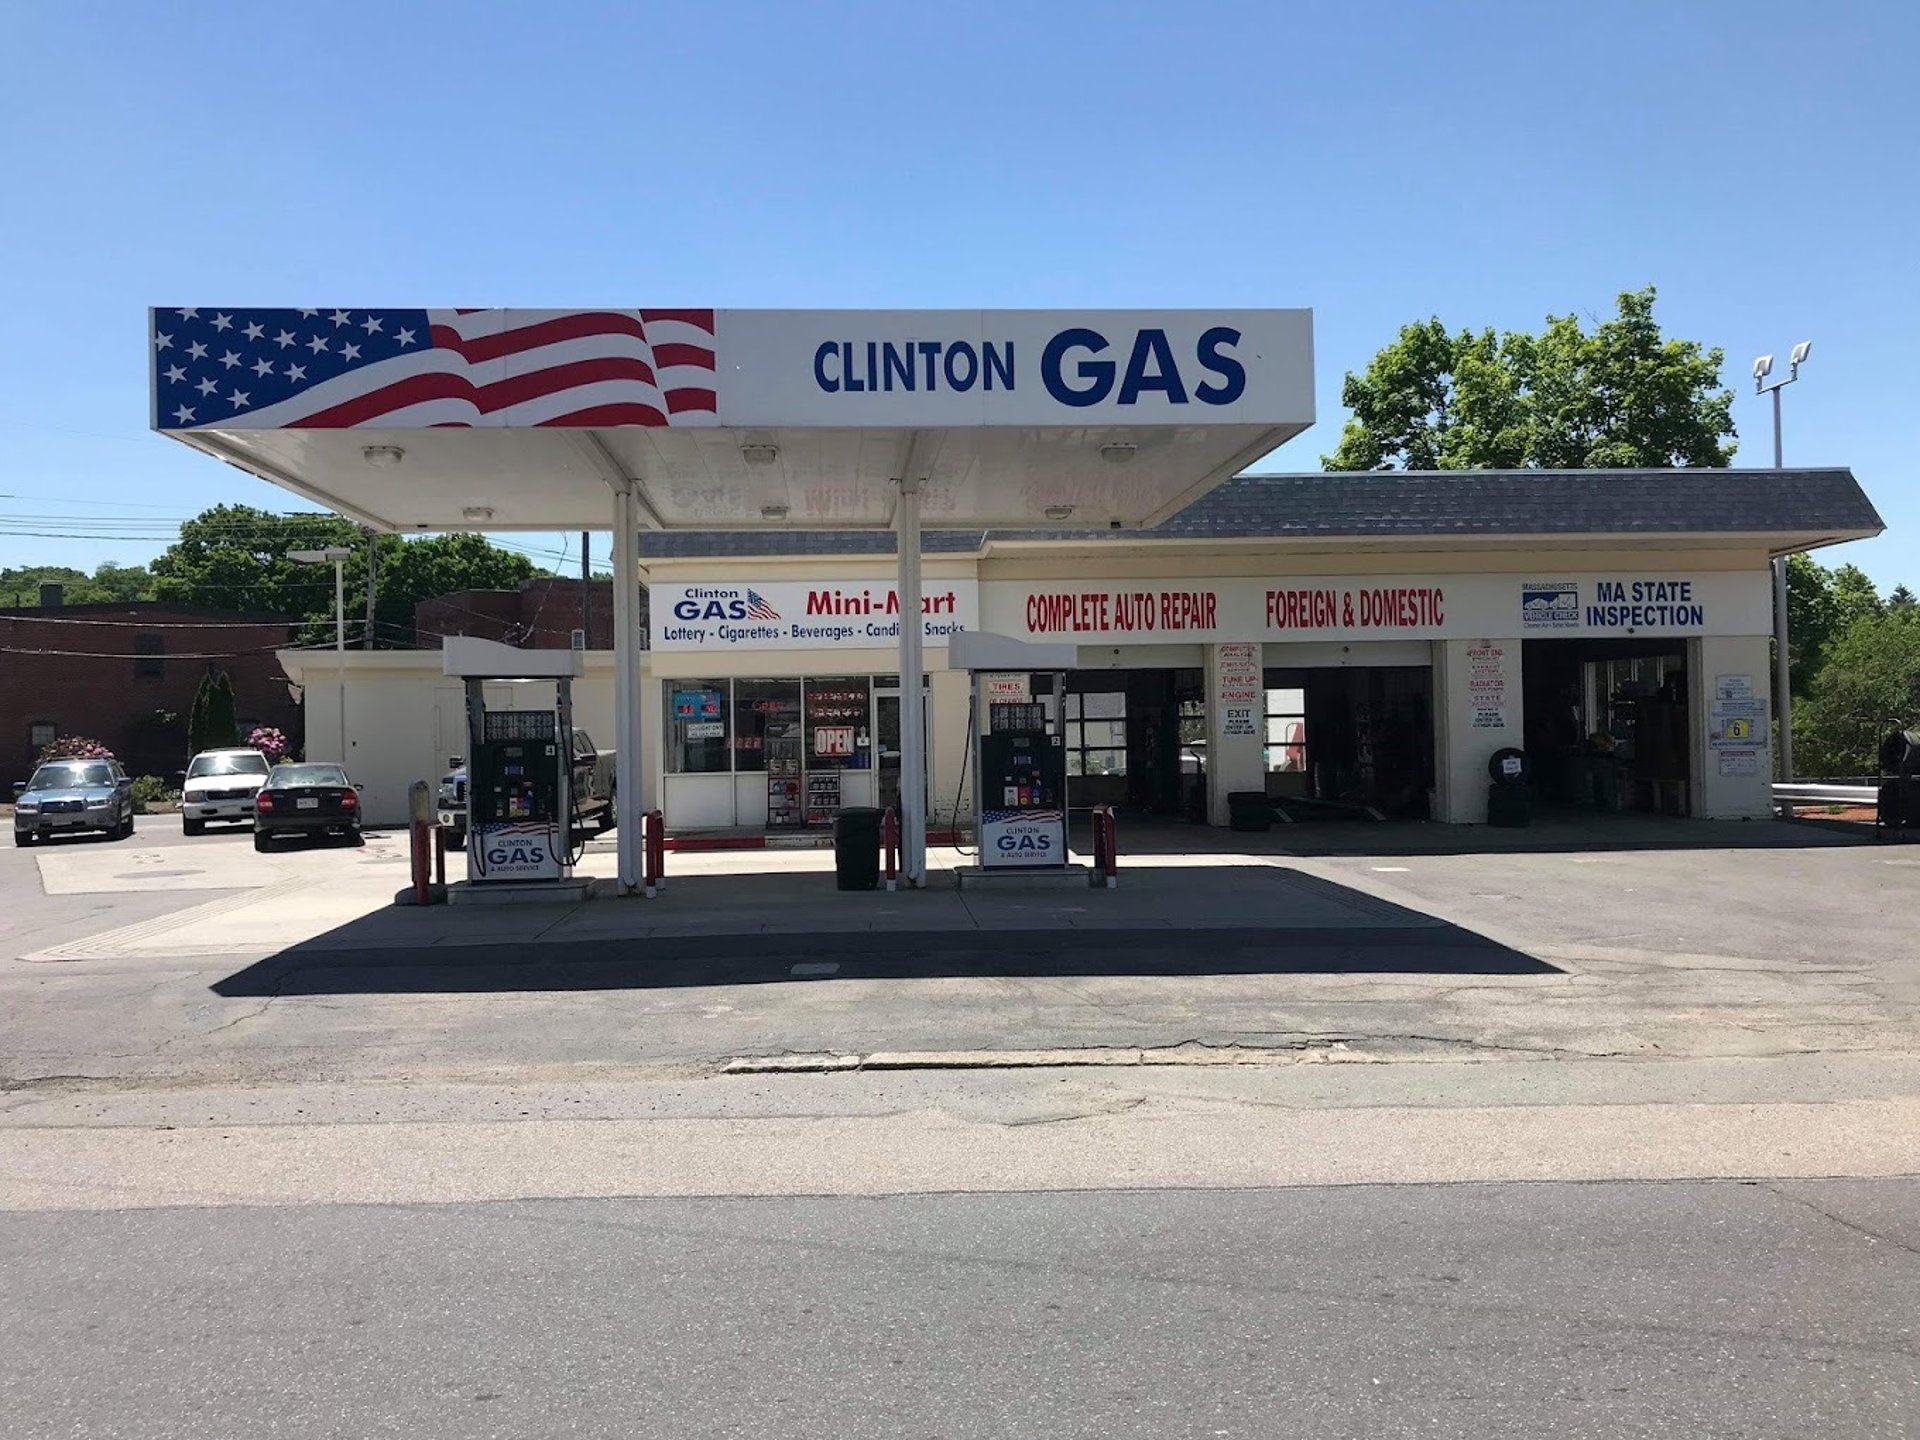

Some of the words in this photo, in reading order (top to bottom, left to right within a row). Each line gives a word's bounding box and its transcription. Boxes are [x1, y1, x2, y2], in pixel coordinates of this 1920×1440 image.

[814, 341, 1015, 393] CLINTON
[1040, 326, 1246, 407] GAS
[685, 588, 738, 599] Clinton
[1597, 582, 1626, 602] MA
[1632, 581, 1691, 601] STATE
[673, 600, 747, 621] GAS
[1027, 593, 1109, 632] COMPLETE
[1114, 592, 1155, 631] AUTO
[1161, 591, 1217, 630] REPAIR
[1266, 590, 1337, 629] FOREIGN
[1342, 591, 1355, 627] &
[1360, 588, 1444, 627] DOMESTIC
[1587, 605, 1703, 627] INSPECTION
[664, 626, 705, 643] Lottery
[718, 625, 779, 642] Cigarettes
[791, 624, 853, 641] Beverages
[866, 622, 899, 638] Candi
[924, 621, 965, 636] Snacks
[1227, 709, 1251, 718] EXIT
[1733, 722, 1740, 736] 6
[816, 729, 854, 753] OPEN
[498, 839, 532, 847] CLINTON
[997, 835, 1051, 851] GAS
[487, 847, 545, 864] GAS
